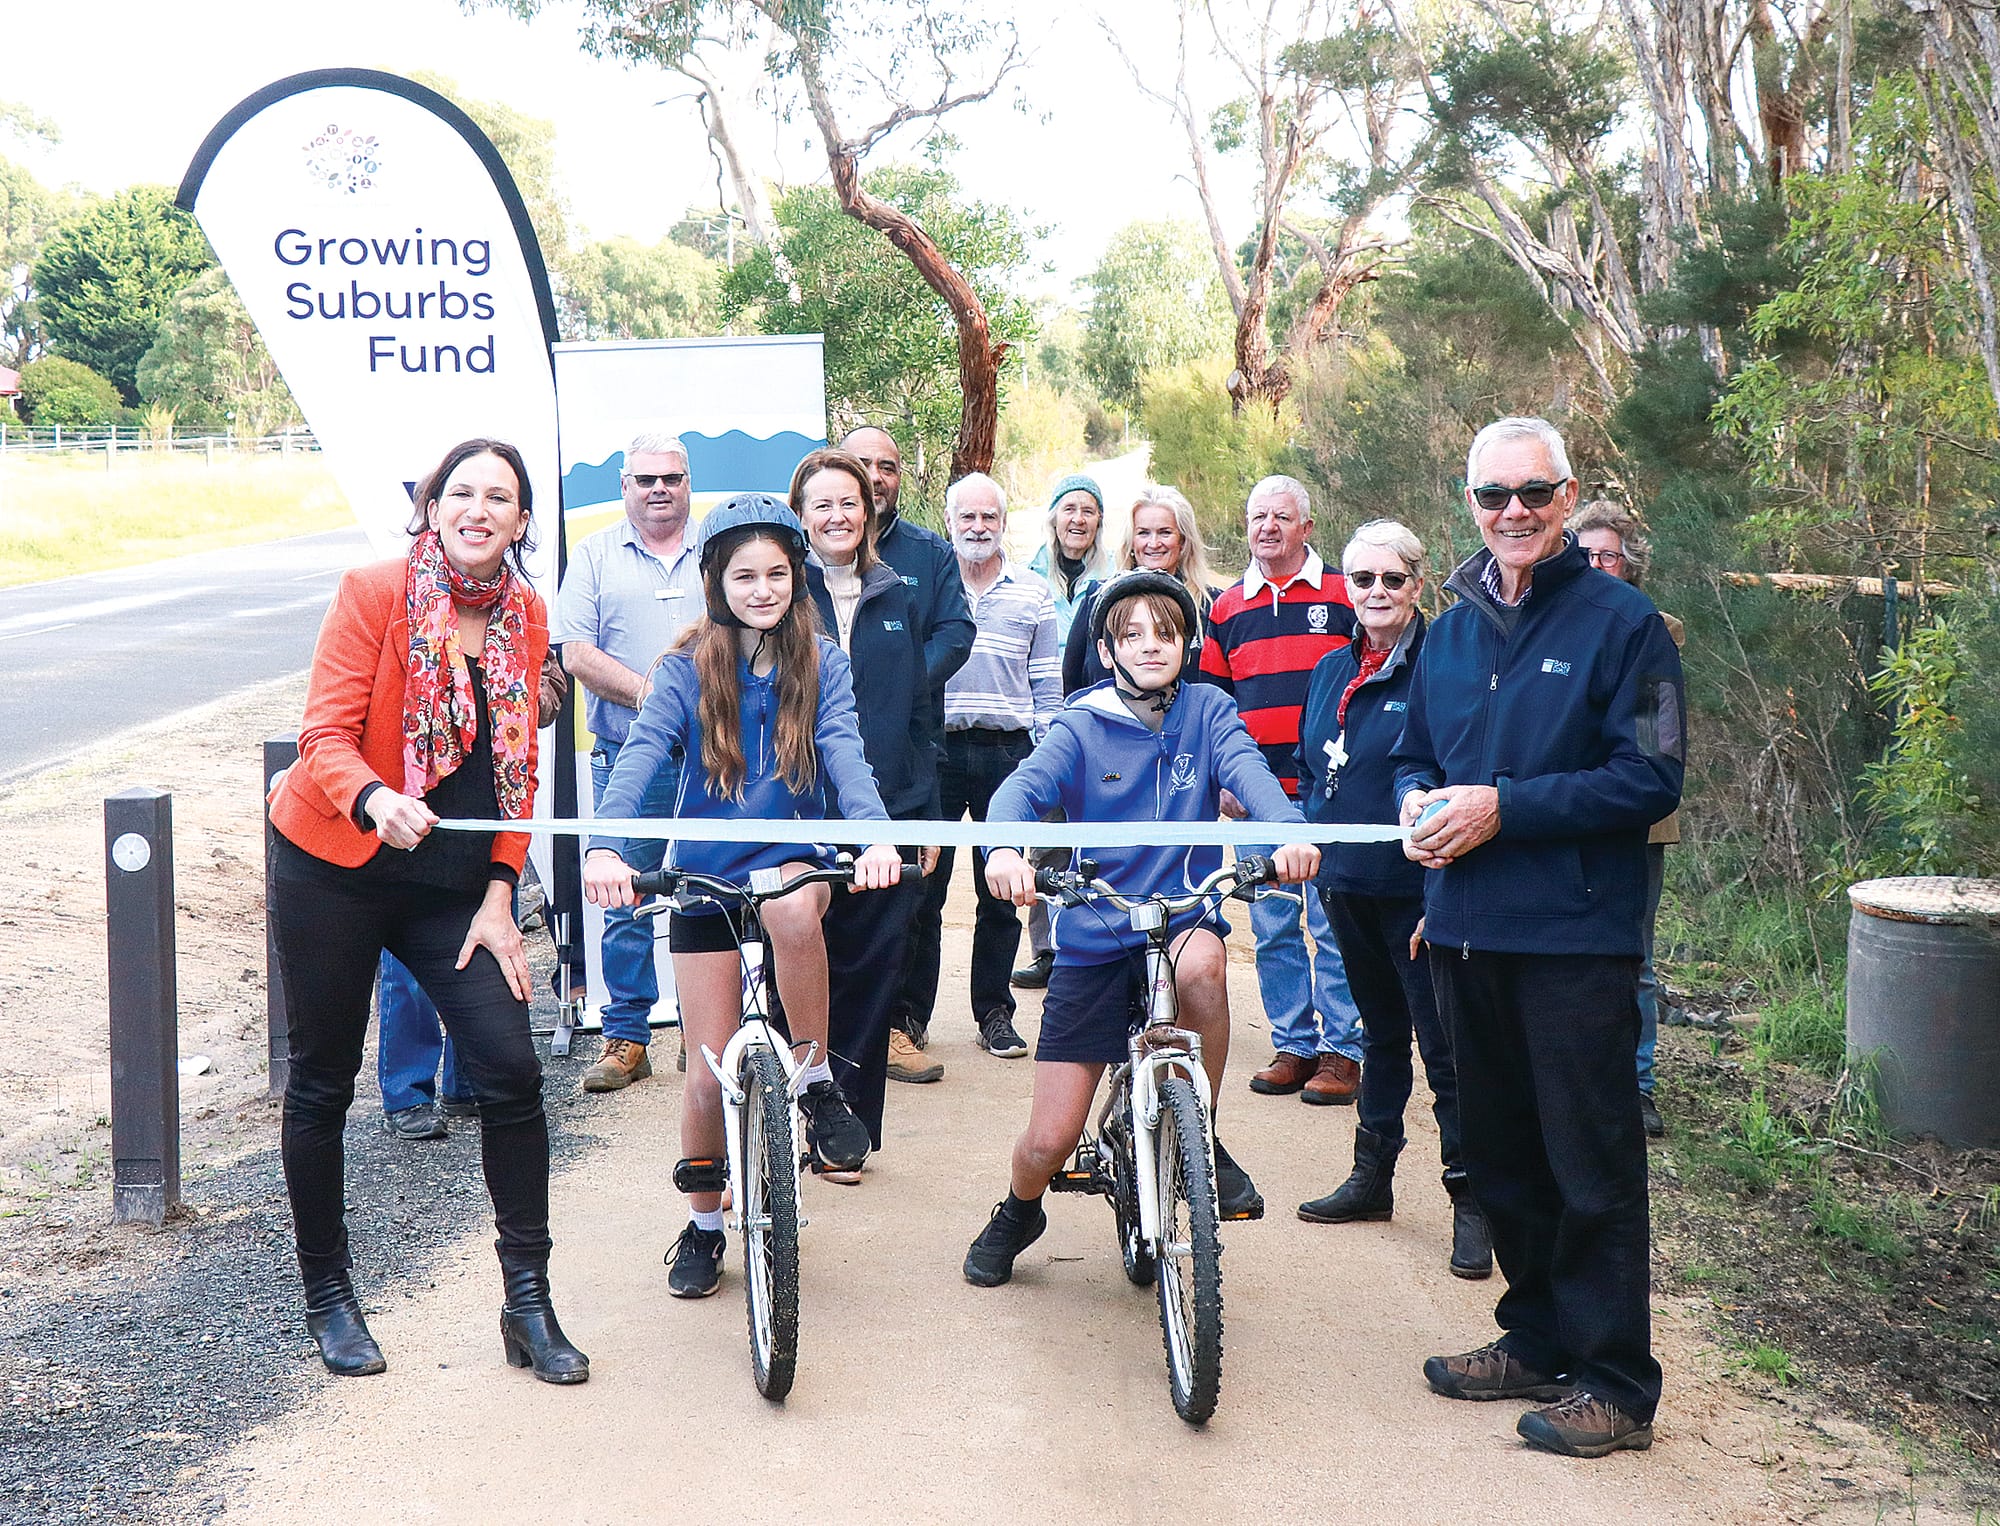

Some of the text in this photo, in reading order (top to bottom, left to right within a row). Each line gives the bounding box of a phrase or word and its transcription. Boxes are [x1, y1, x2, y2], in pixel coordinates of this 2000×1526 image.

[274, 227, 490, 276] Growing
[286, 279, 495, 321] Suburbs
[368, 334, 496, 374] Fund
